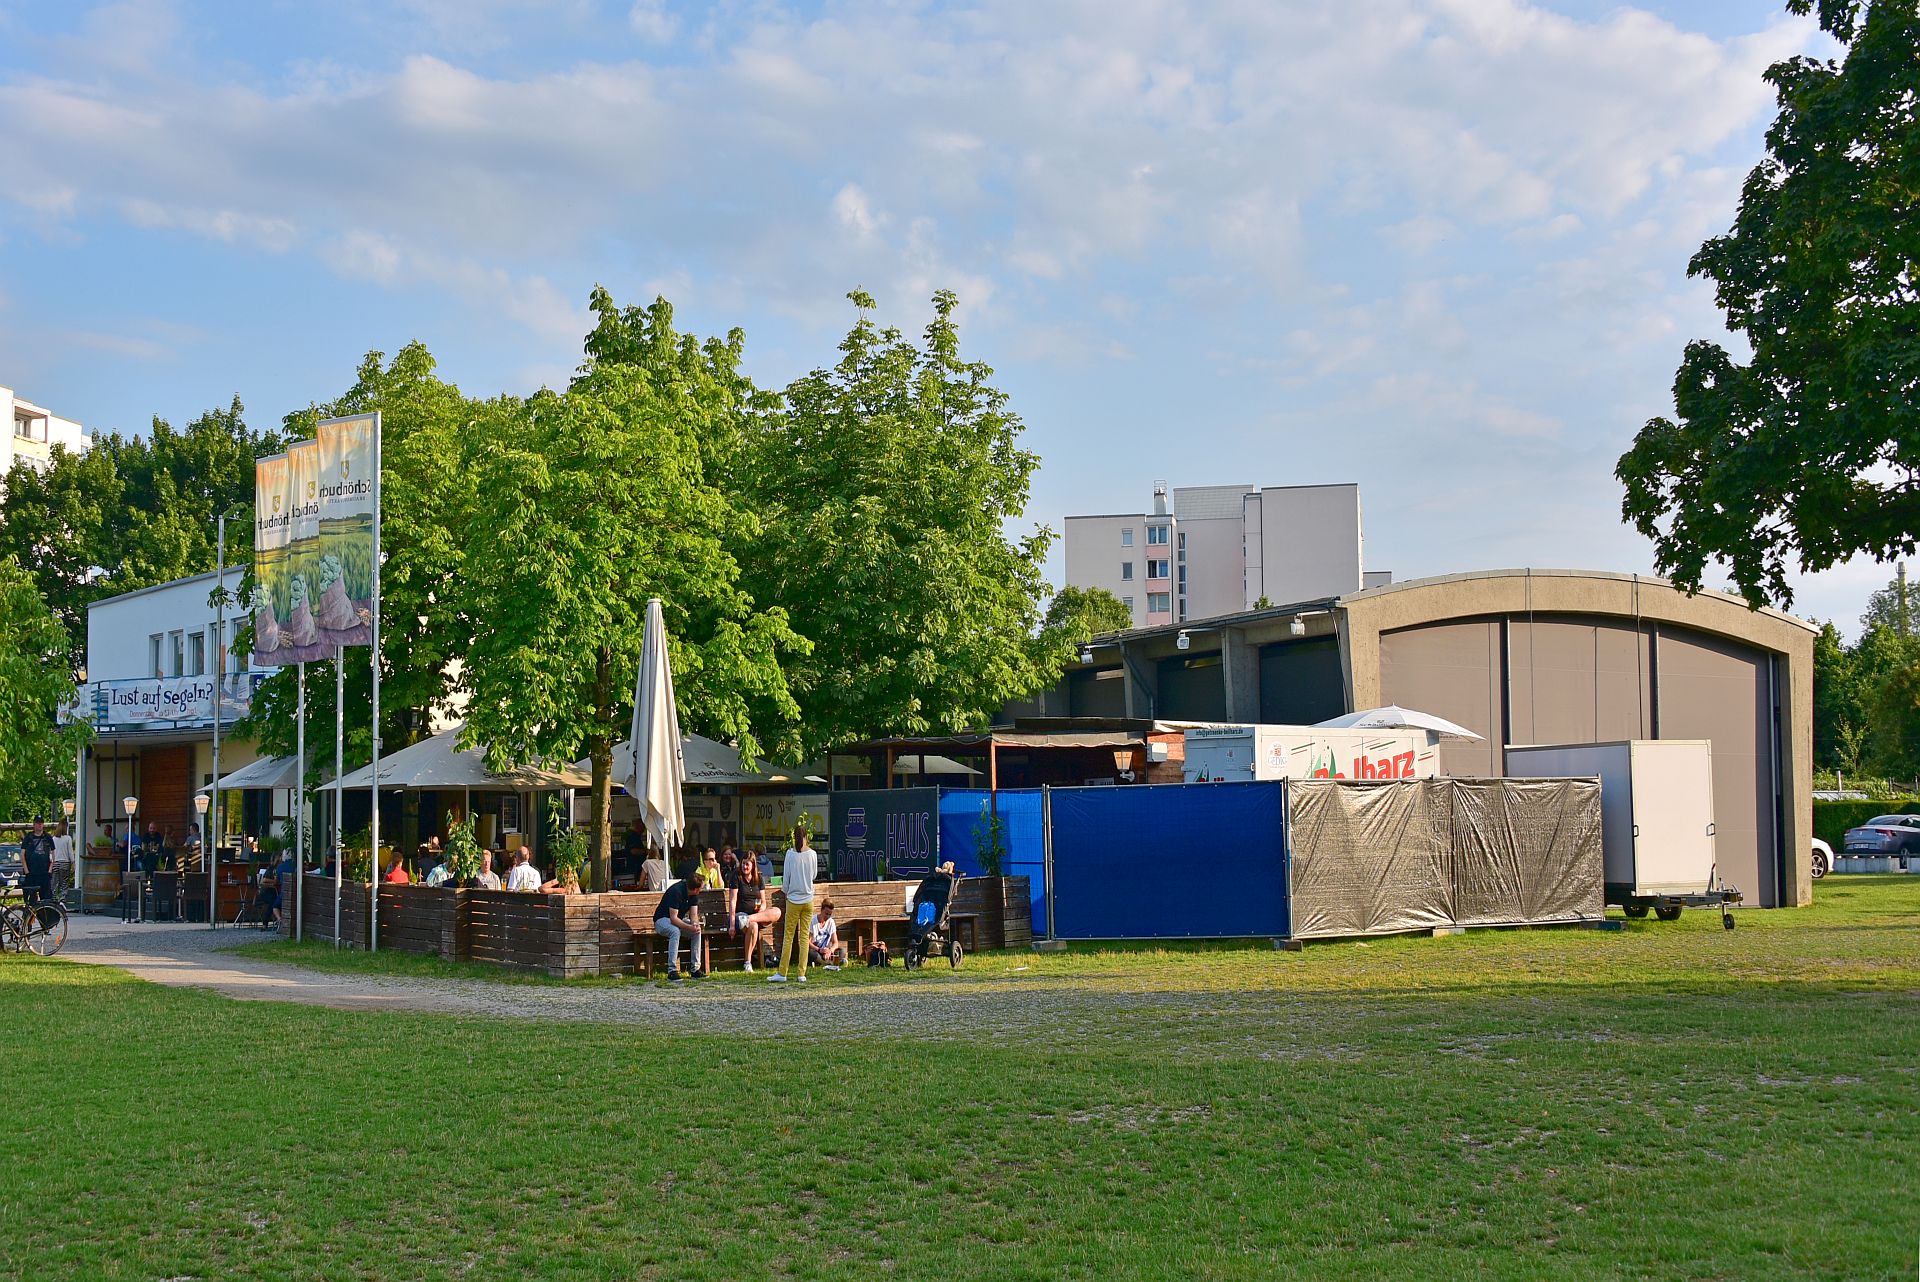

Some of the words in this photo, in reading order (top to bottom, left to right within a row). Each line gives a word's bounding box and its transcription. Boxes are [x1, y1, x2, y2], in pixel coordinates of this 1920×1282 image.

[112, 687, 139, 705] Lust
[142, 684, 161, 712] auf
[163, 683, 213, 712] Segeln?
[756, 804, 773, 820] 2019
[886, 812, 930, 860] HAUS
